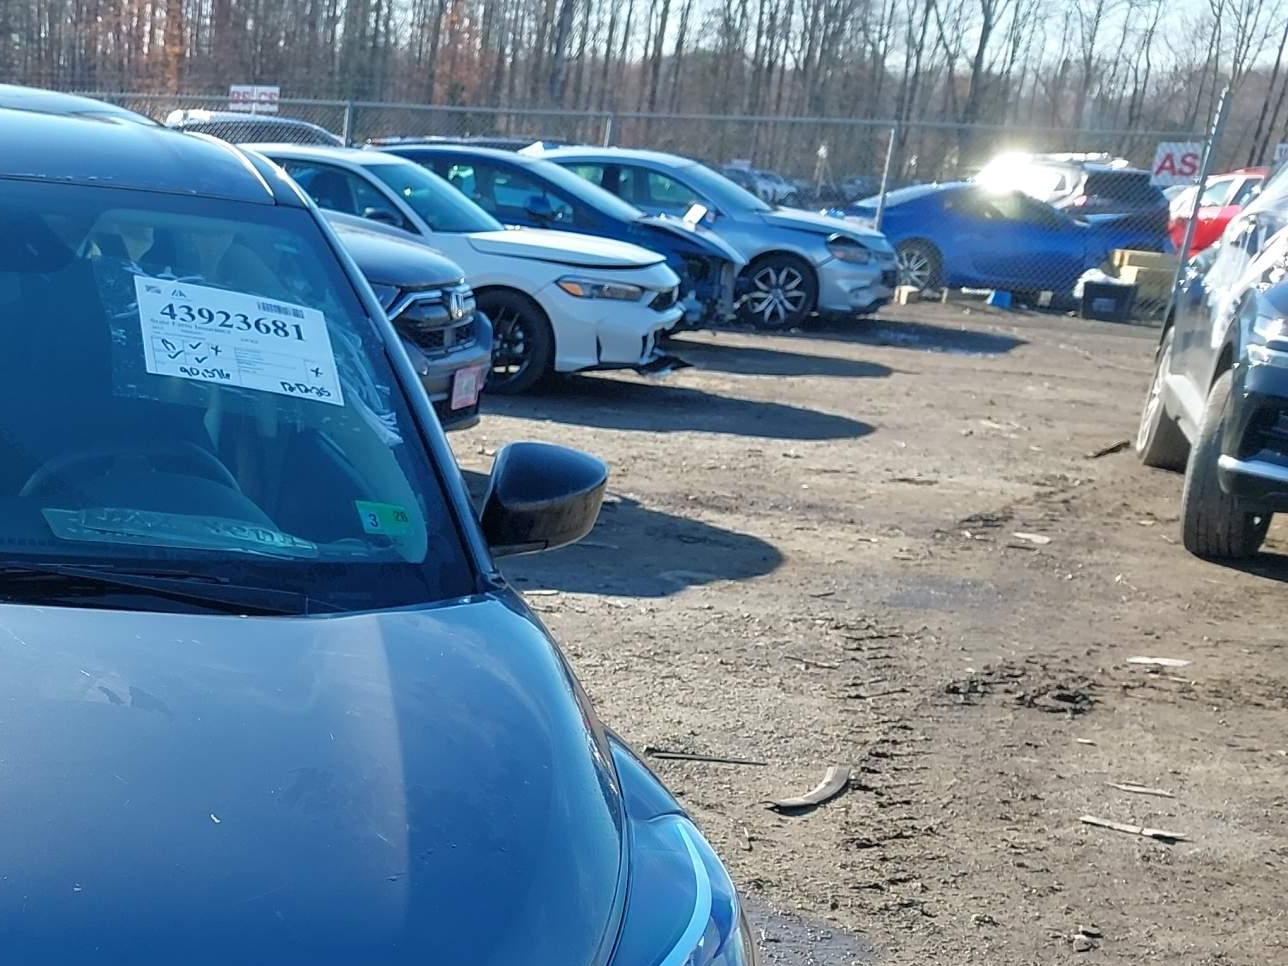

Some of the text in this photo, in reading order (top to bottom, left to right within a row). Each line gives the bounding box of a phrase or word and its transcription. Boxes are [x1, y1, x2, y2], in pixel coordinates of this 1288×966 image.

[1154, 152, 1199, 177] AS
[159, 303, 307, 342] 43923681
[368, 512, 379, 528] 3
